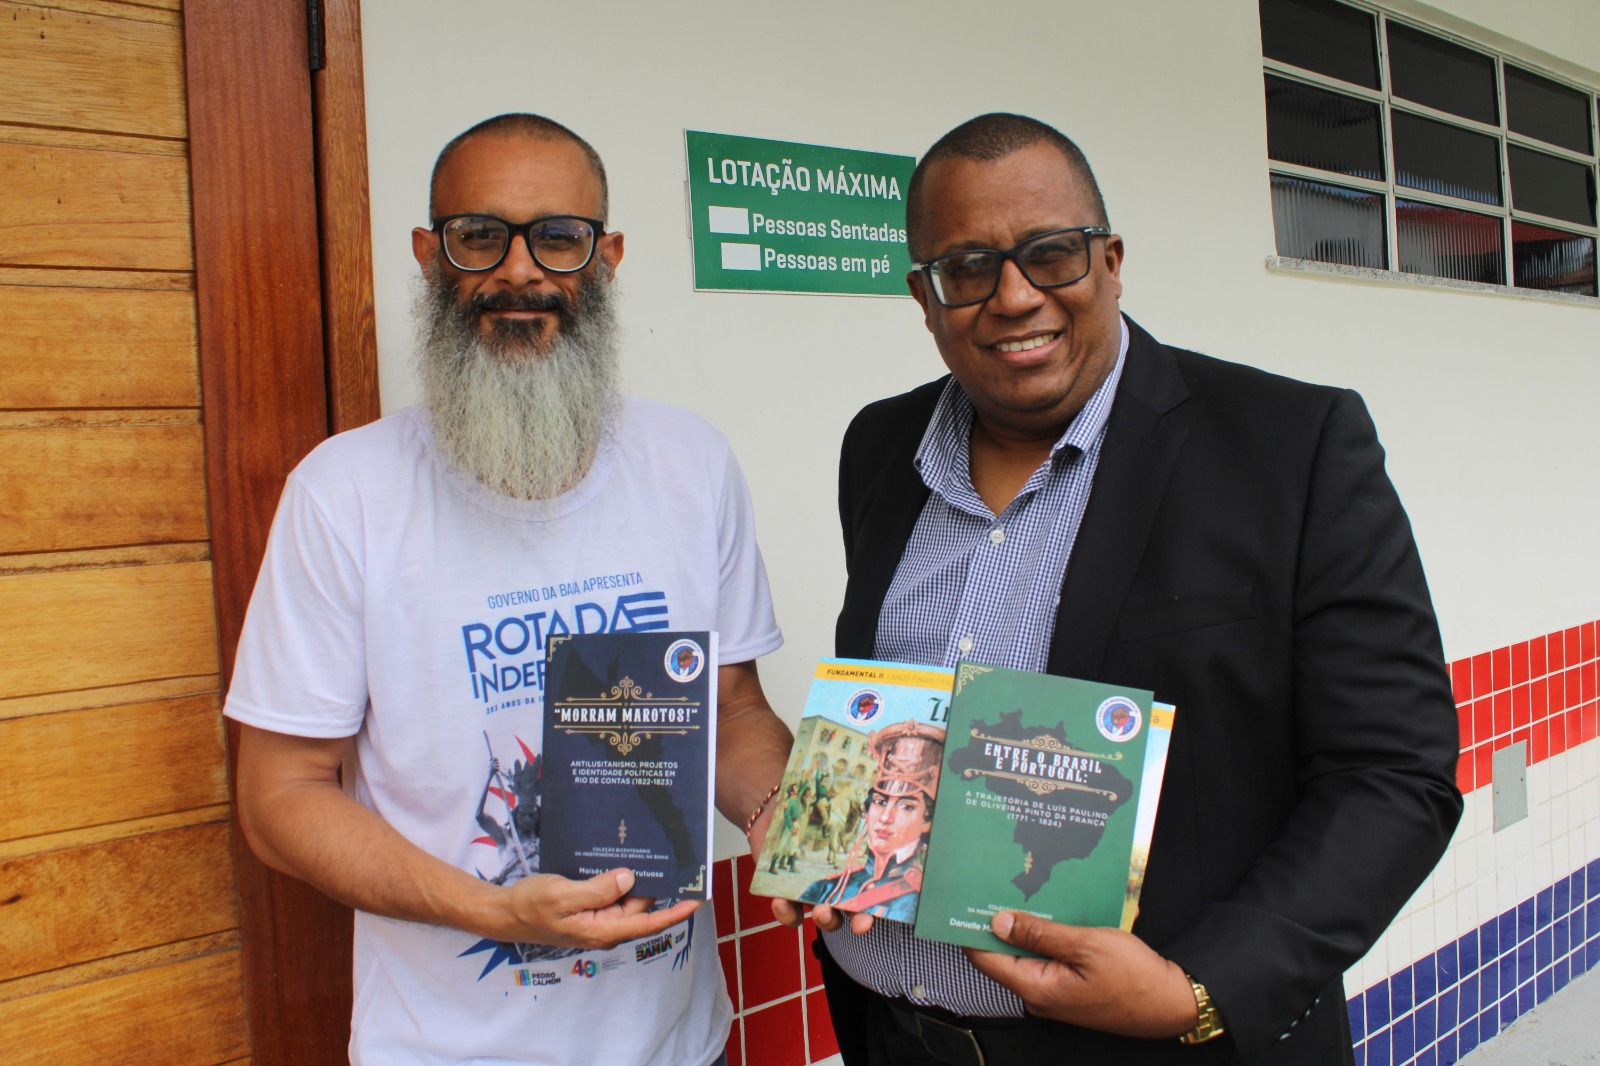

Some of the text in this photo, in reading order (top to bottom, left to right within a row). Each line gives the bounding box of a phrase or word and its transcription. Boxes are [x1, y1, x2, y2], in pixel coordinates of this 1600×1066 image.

[707, 157, 902, 201] LOTAÇÃO MÁXIMA
[752, 212, 907, 243] Pessoas Sentadas
[764, 248, 891, 278] Pessoas em pé
[487, 588, 540, 609] GOVERNO
[542, 586, 558, 600] DA
[583, 571, 644, 592] APRESENTA
[827, 669, 877, 679] FUNDAMENTAL
[501, 697, 522, 709] ANOS
[525, 697, 535, 705] DA
[570, 760, 678, 770] ANTILUSITANISMO, PROJETOS
[984, 742, 1102, 774] ENTRE O BRASIL
[578, 768, 623, 776] IDENTIDADE
[624, 768, 663, 777] POLÍTICAS
[995, 757, 1088, 784] E PORTUGAL:
[574, 776, 588, 784] RIO
[600, 777, 631, 785] CONTAS
[631, 778, 673, 787] (1822-1823)
[966, 798, 1106, 828] DE OLIVEIRA PINTO DA FRANÇA
[975, 792, 1029, 807] TRAJETÓRIA
[1032, 800, 1044, 809] DE
[1047, 801, 1067, 813] LUÍS
[1069, 806, 1108, 820] PAULINO
[1006, 813, 1028, 822] (1771
[1039, 817, 1062, 828] 1824)
[579, 867, 603, 875] Moisés
[949, 917, 981, 931] Danielle
[532, 971, 556, 979] PEDRO
[532, 976, 561, 986] CALMON
